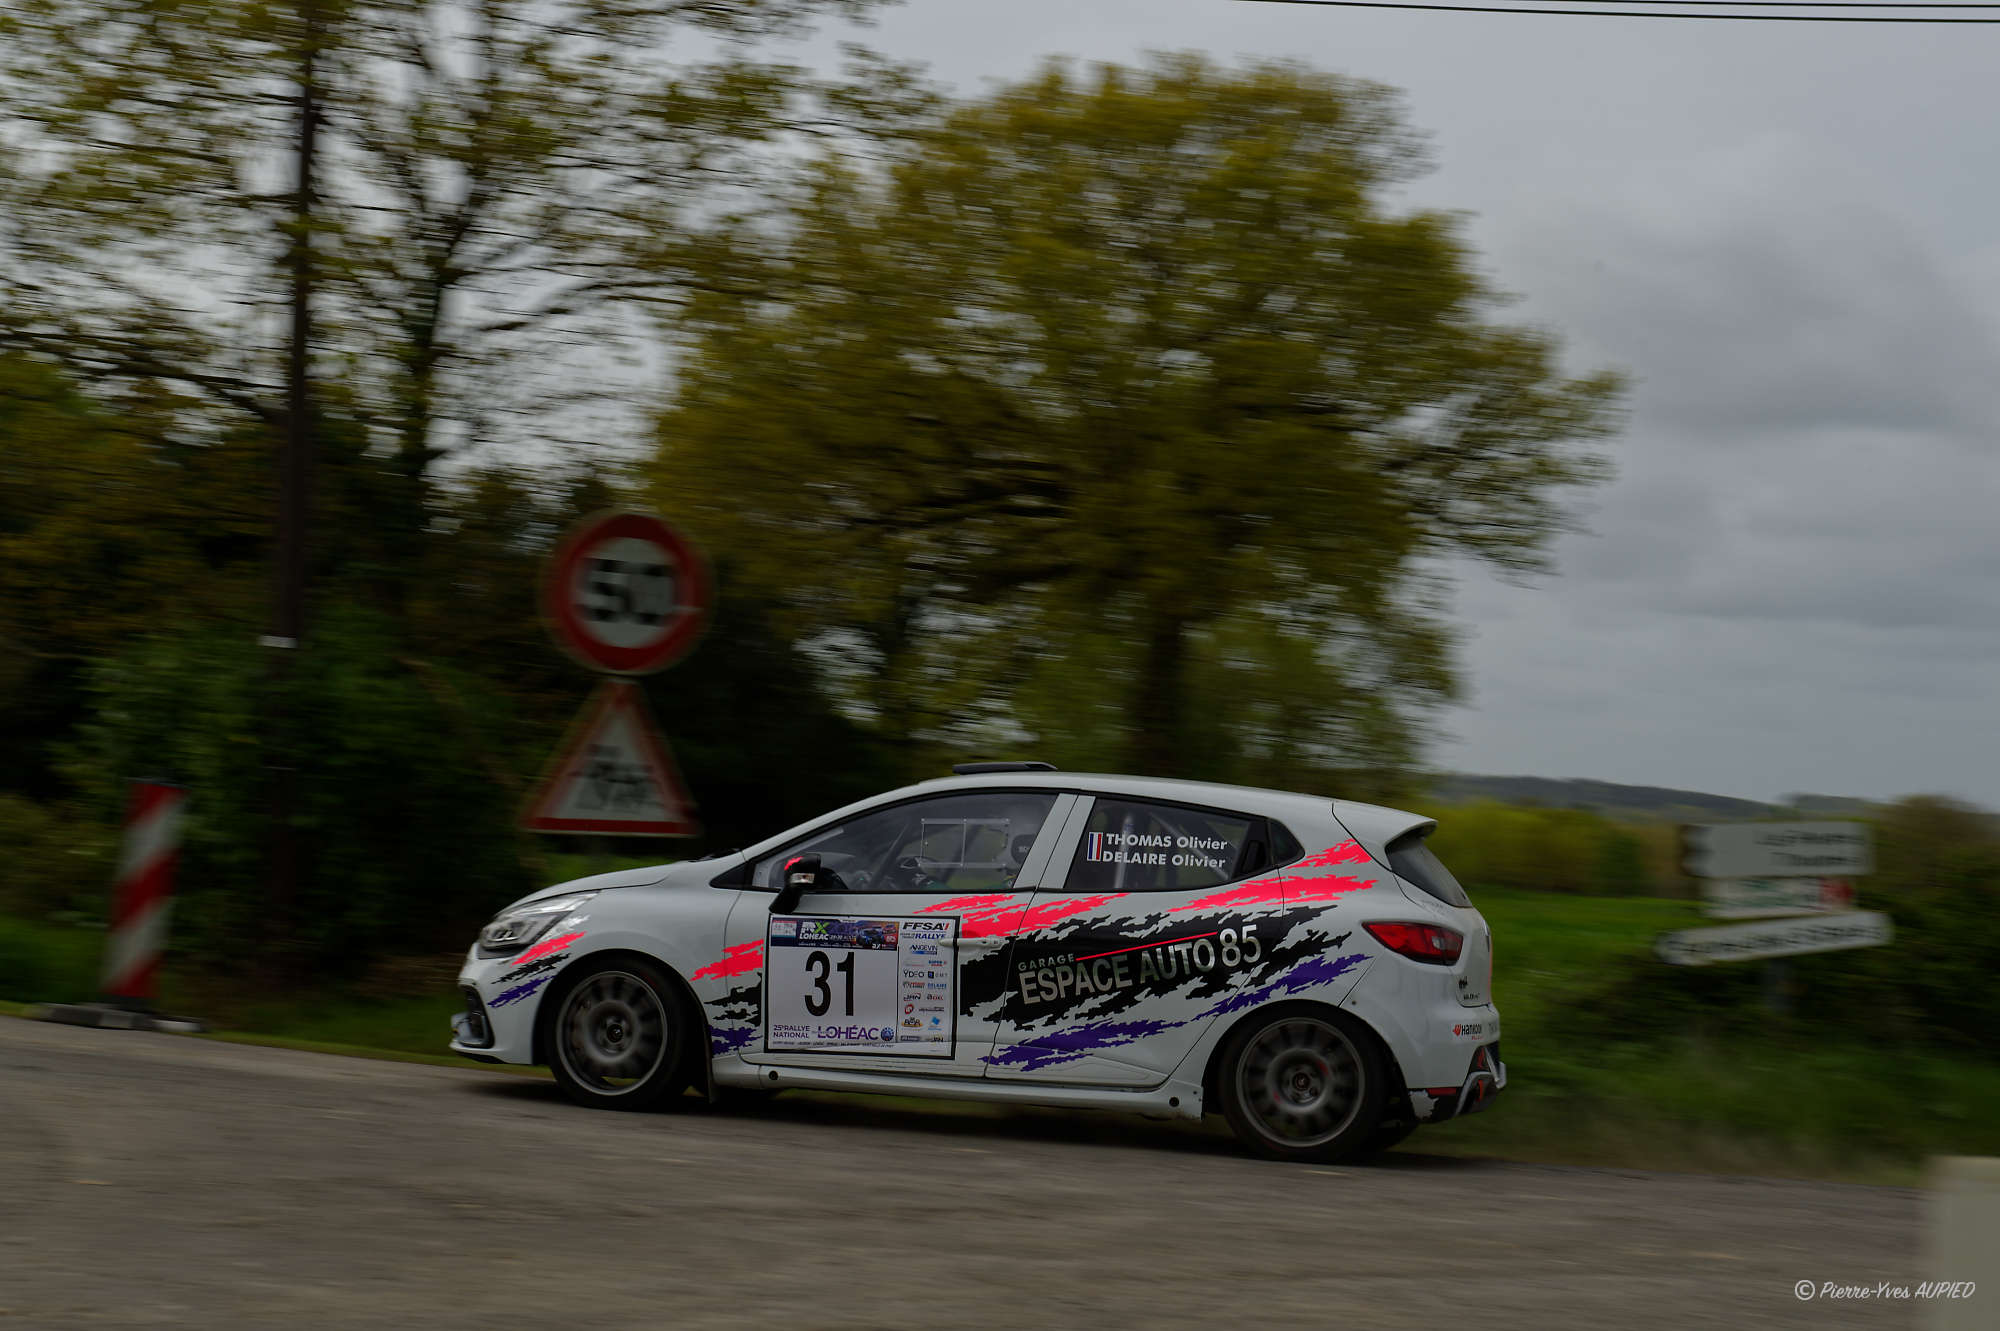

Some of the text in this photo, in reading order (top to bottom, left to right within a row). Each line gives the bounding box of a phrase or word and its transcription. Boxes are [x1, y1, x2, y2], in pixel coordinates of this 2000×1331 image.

[578, 557, 677, 627] 50
[1106, 833, 1228, 850] THOMAS Olivier
[1102, 850, 1226, 868] DELAIRE Olivier
[903, 922, 944, 931] FFSA
[1018, 953, 1075, 971] GARAGE
[1018, 924, 1262, 1005] ESPACE AUTO 85
[805, 950, 854, 1016] 31
[817, 1025, 879, 1040] LOHÉAC
